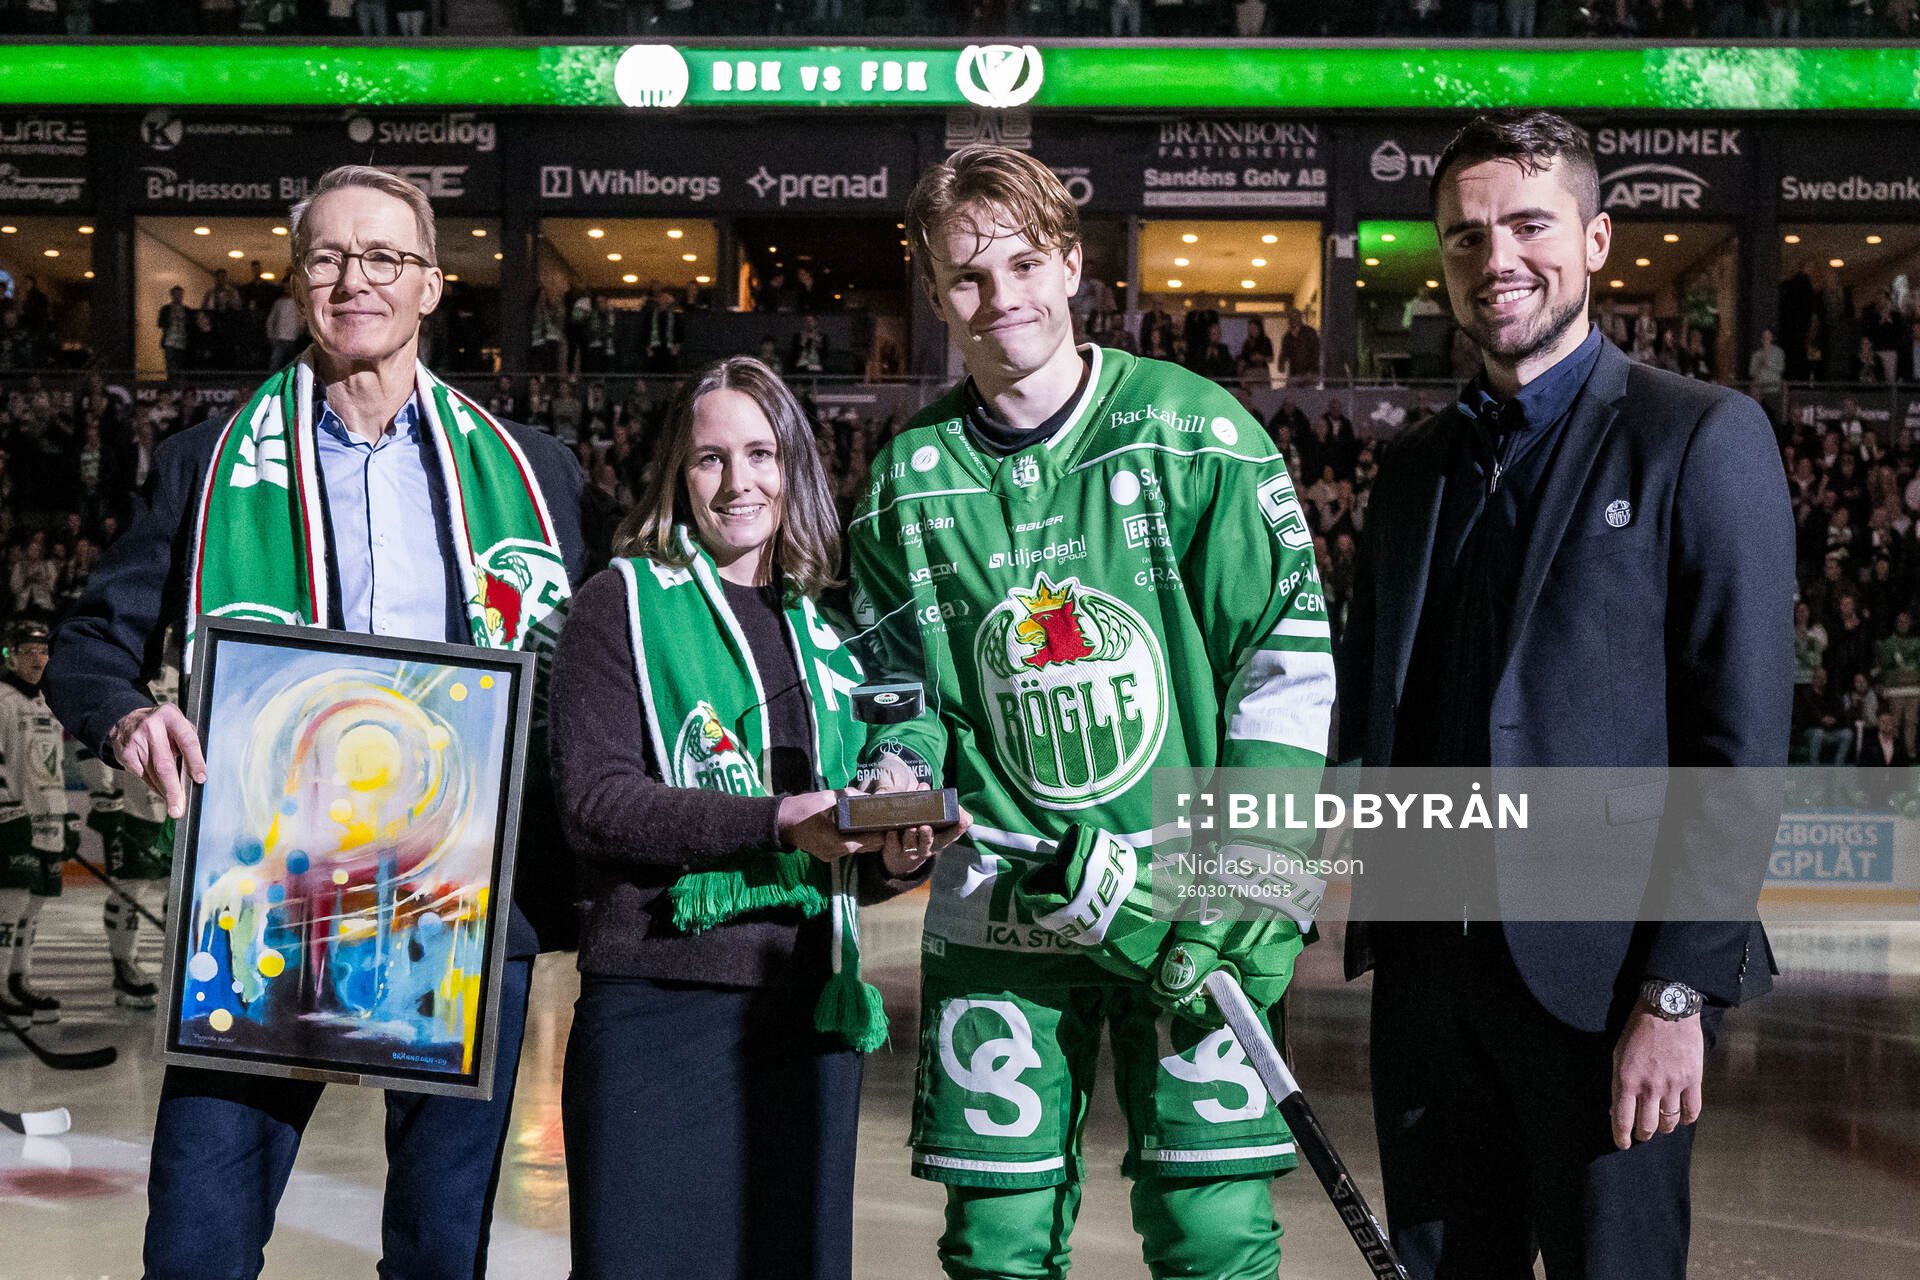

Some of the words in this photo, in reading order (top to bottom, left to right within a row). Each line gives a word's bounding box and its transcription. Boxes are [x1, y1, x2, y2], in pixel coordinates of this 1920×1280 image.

[712, 61, 782, 91] RBK
[861, 61, 928, 91] FBK
[1597, 129, 1741, 155] SMIDMEK
[578, 169, 721, 200] Wihlborgs
[780, 166, 888, 206] prenad
[1243, 168, 1291, 187] Golv
[1297, 169, 1327, 187] AB
[1604, 182, 1701, 209] APIR
[1111, 404, 1206, 434] Backahill
[1057, 550, 1087, 566] group
[995, 672, 1145, 788] RÖGLE
